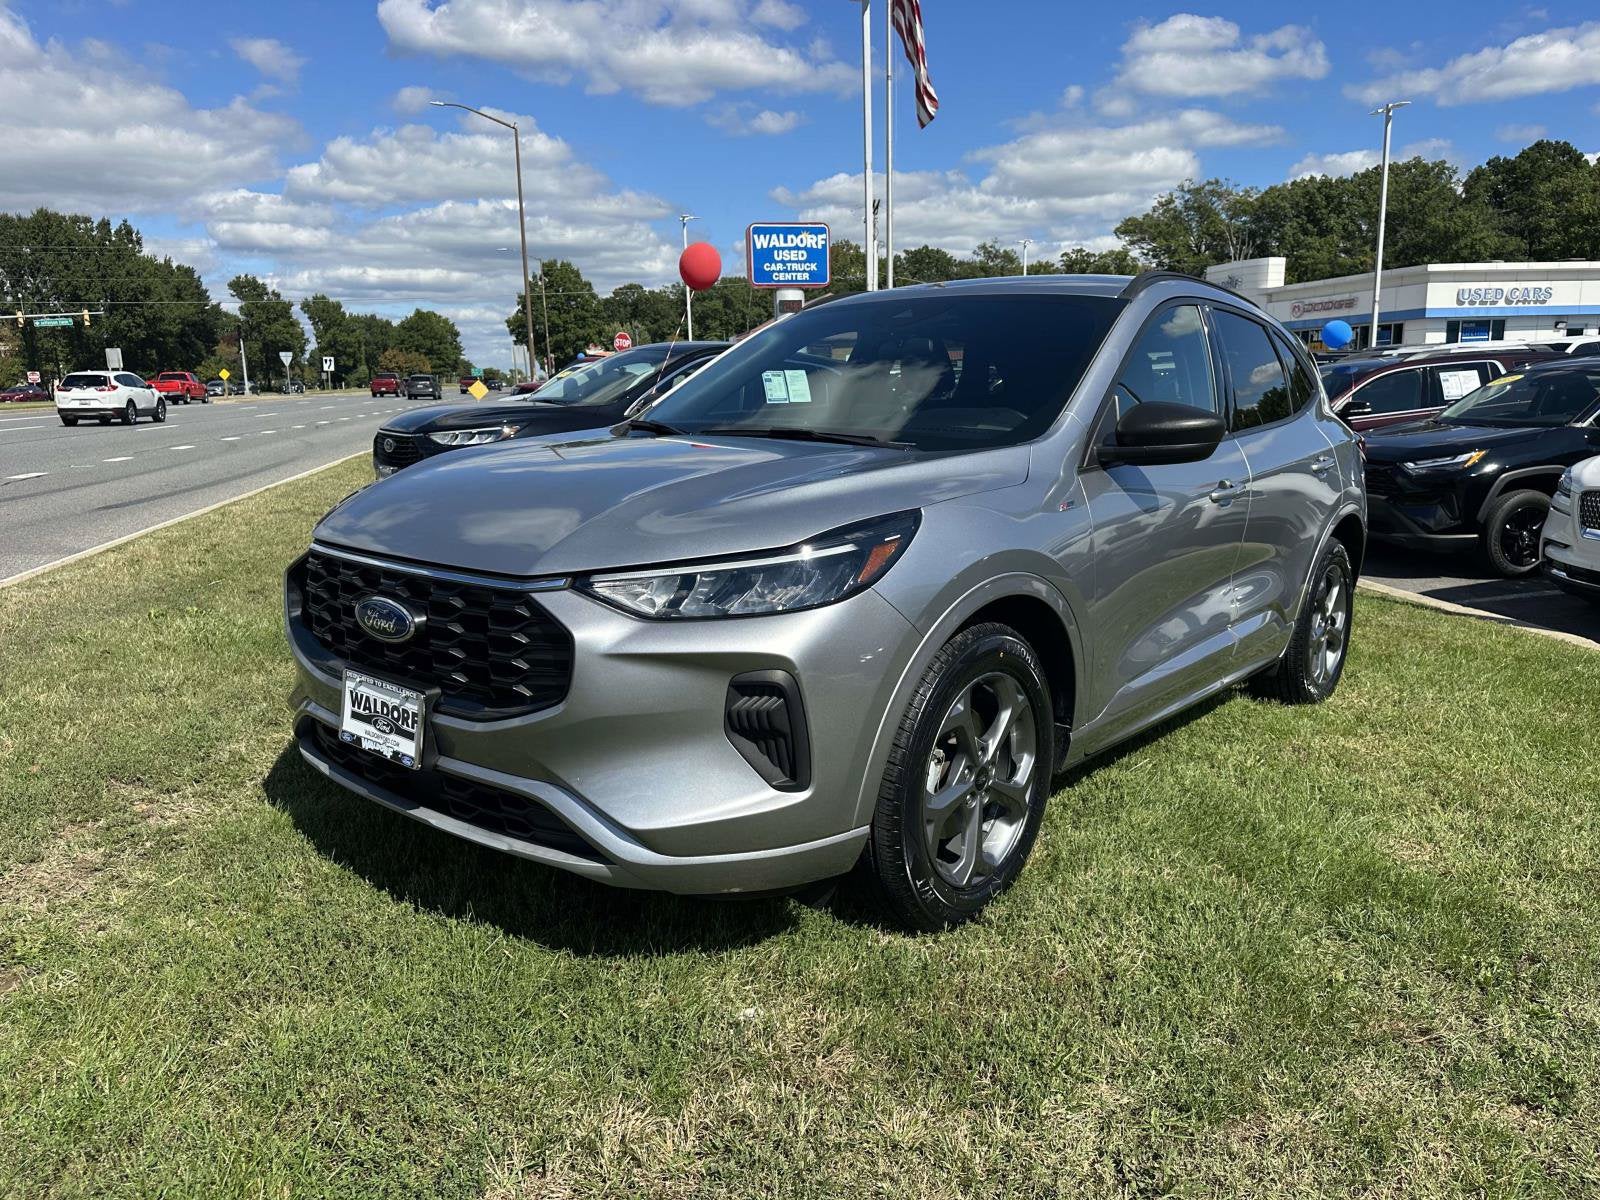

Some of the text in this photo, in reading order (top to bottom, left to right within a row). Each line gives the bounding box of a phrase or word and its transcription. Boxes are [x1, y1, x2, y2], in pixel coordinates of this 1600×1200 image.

[753, 233, 827, 249] WALDORF
[773, 250, 808, 261] USED
[763, 262, 818, 272] CAR-TRUCK
[772, 272, 810, 281] CENTER
[1460, 286, 1553, 301] USED CARS
[615, 338, 631, 348] STOP
[364, 607, 397, 634] Ford
[346, 670, 418, 699] DEDICATED TO EXCELLENCE
[350, 689, 419, 730] WALDORF
[375, 719, 391, 733] Ford
